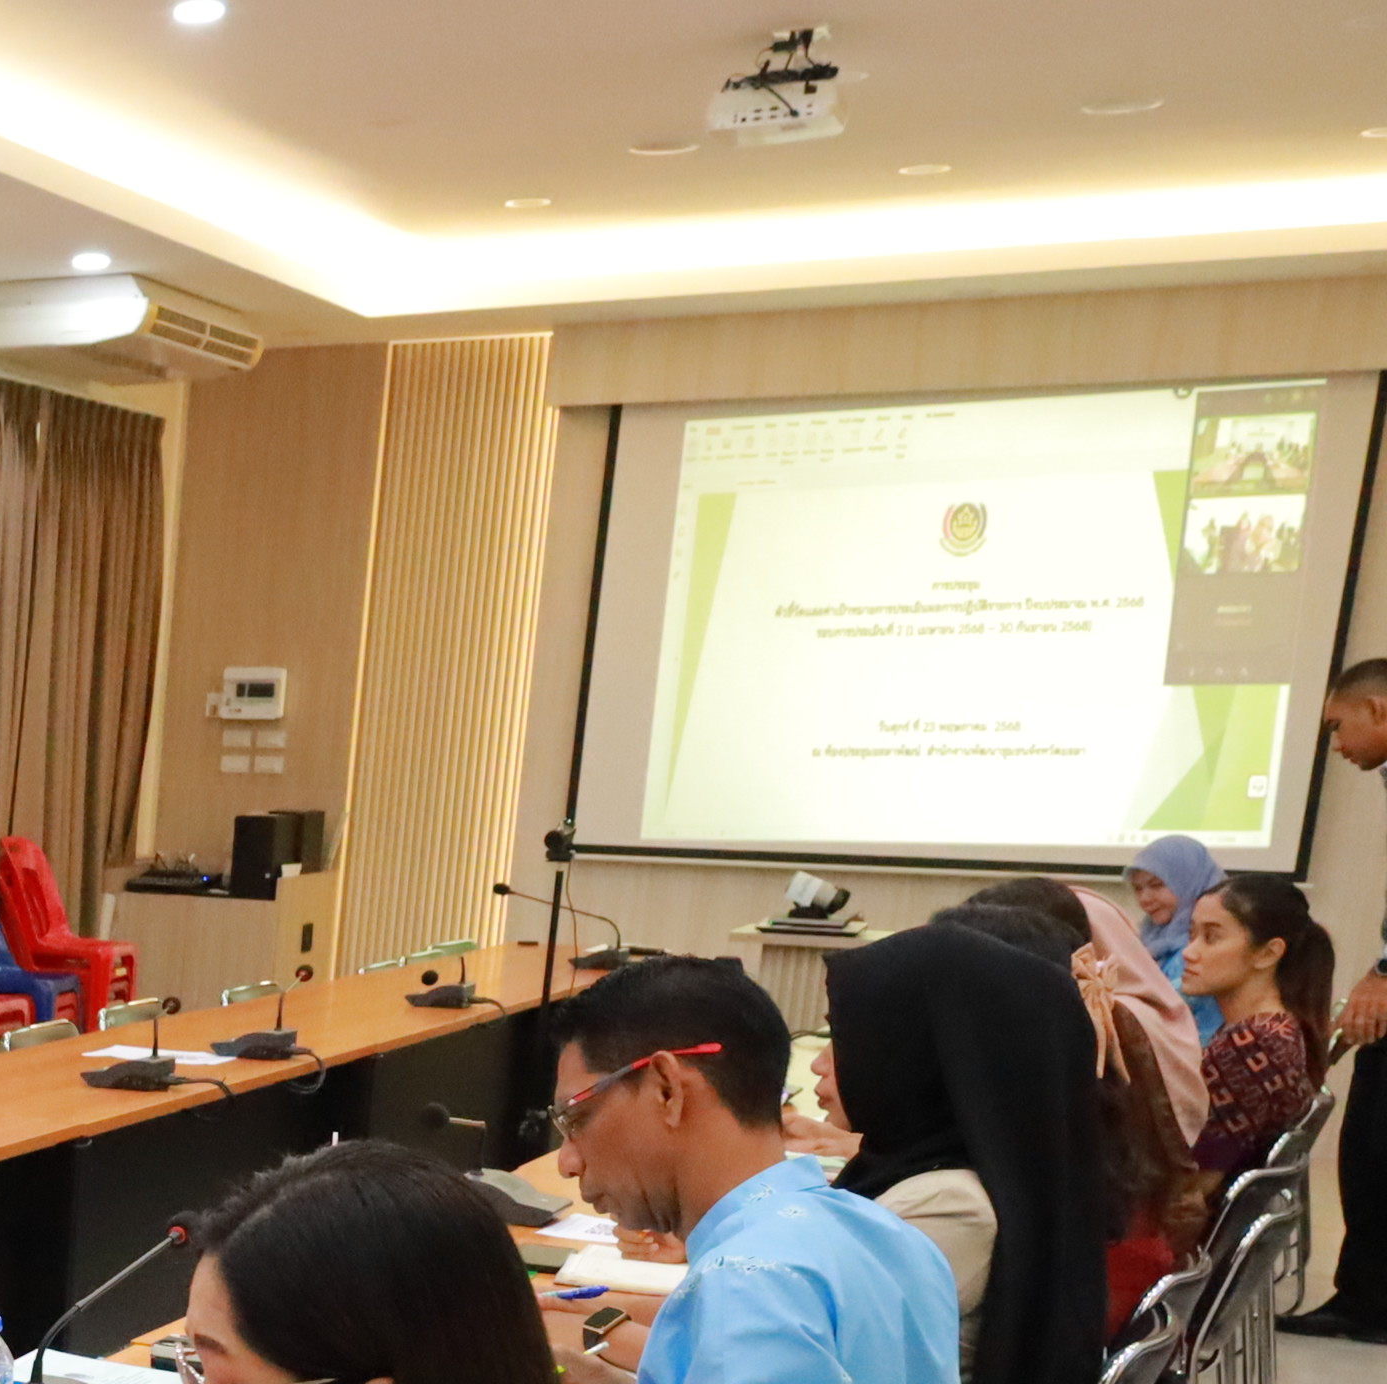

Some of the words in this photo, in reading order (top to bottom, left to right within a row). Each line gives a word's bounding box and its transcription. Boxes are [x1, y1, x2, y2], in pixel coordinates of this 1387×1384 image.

[1116, 596, 1144, 608] 2568
[958, 623, 985, 635] 2568
[999, 622, 1013, 633] 30
[923, 722, 935, 733] 23
[994, 721, 1021, 732] 2568
